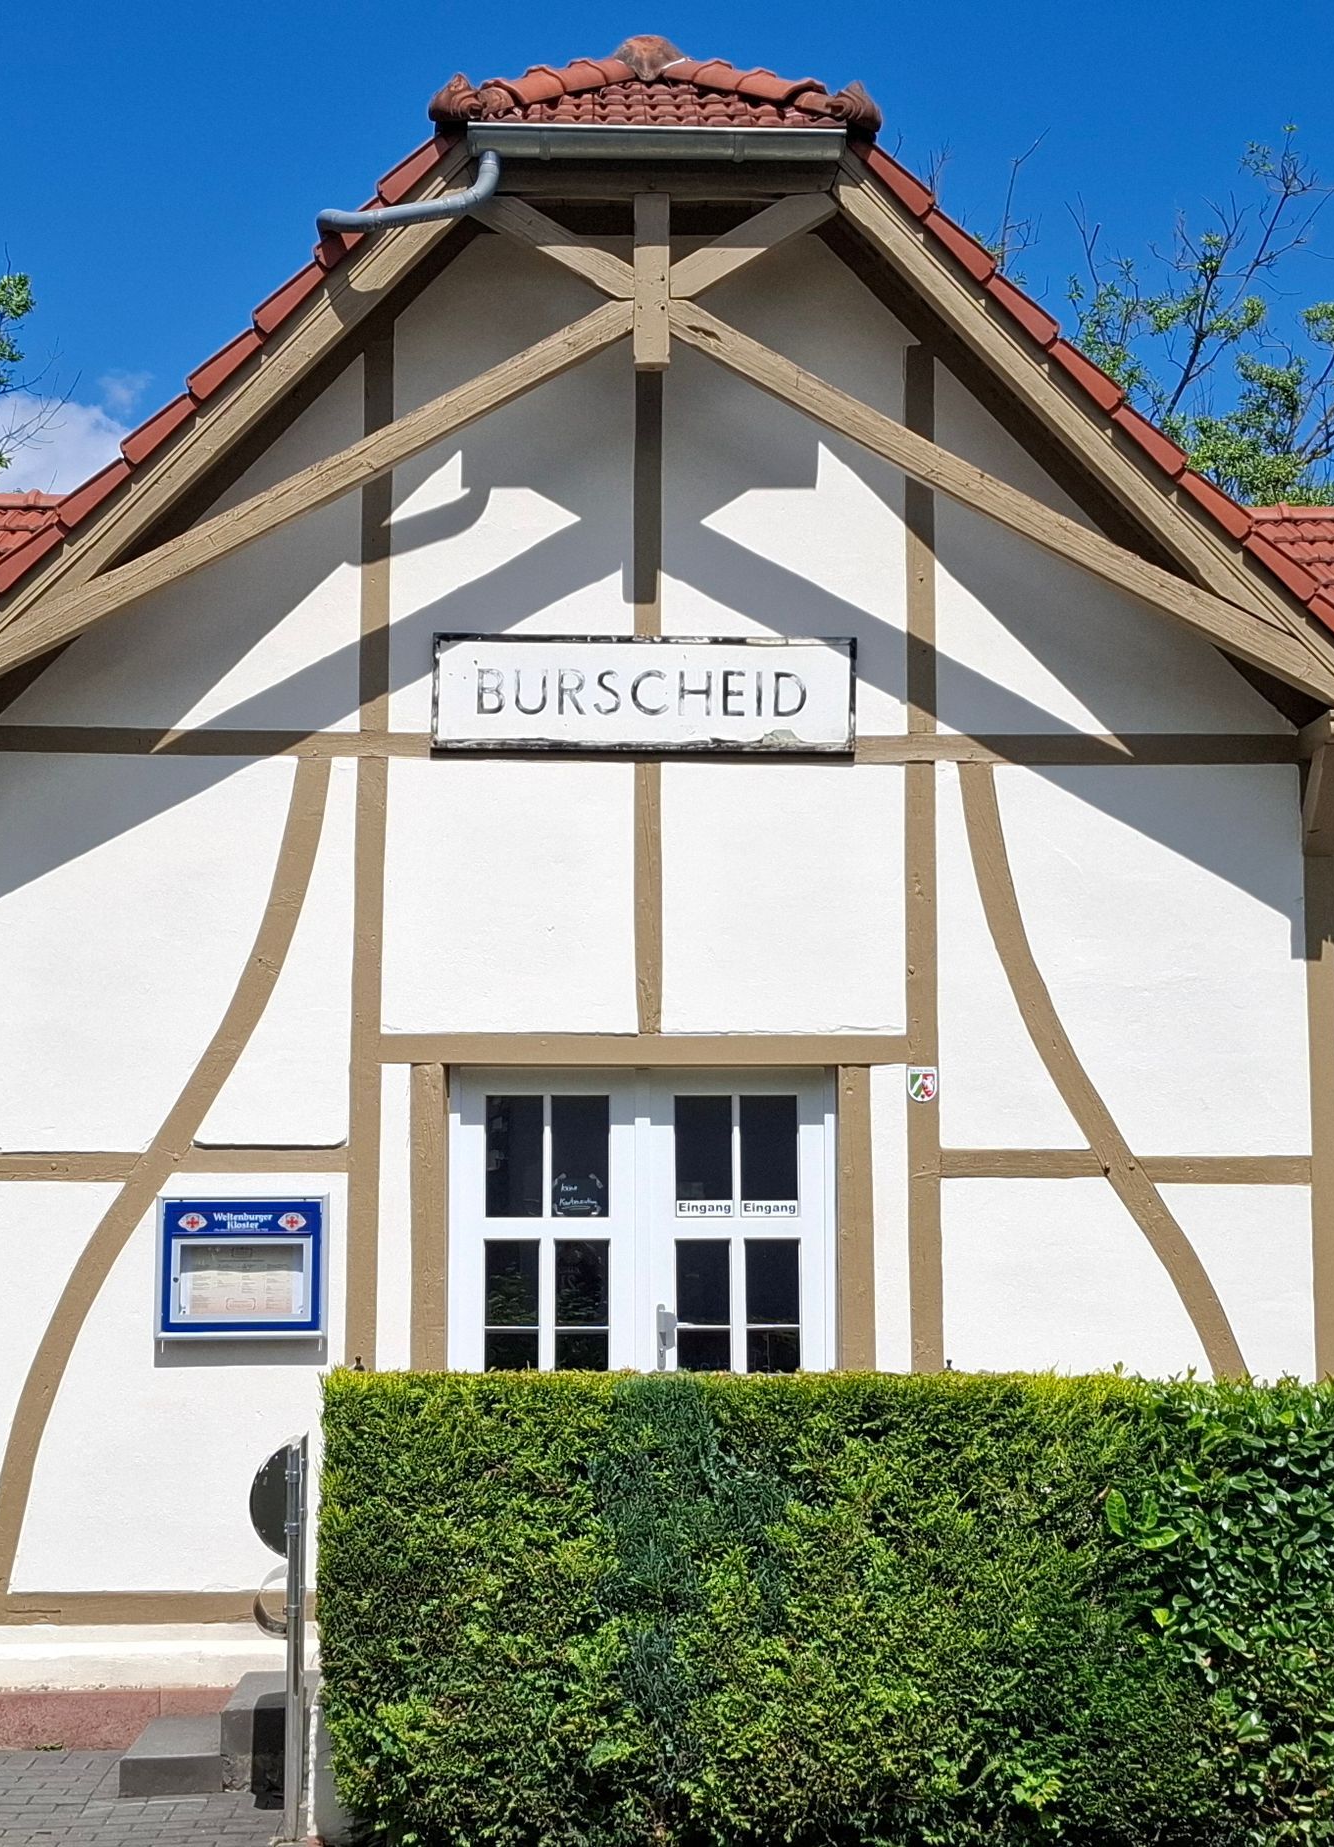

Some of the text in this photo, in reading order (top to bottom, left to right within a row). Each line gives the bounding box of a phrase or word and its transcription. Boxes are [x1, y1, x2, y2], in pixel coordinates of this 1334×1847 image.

[475, 667, 808, 718] BURSCHEID
[678, 1202, 732, 1214] Eingang
[743, 1202, 796, 1214] Eingang
[212, 1212, 273, 1223] Weltenburger
[227, 1221, 259, 1229] Kloster
